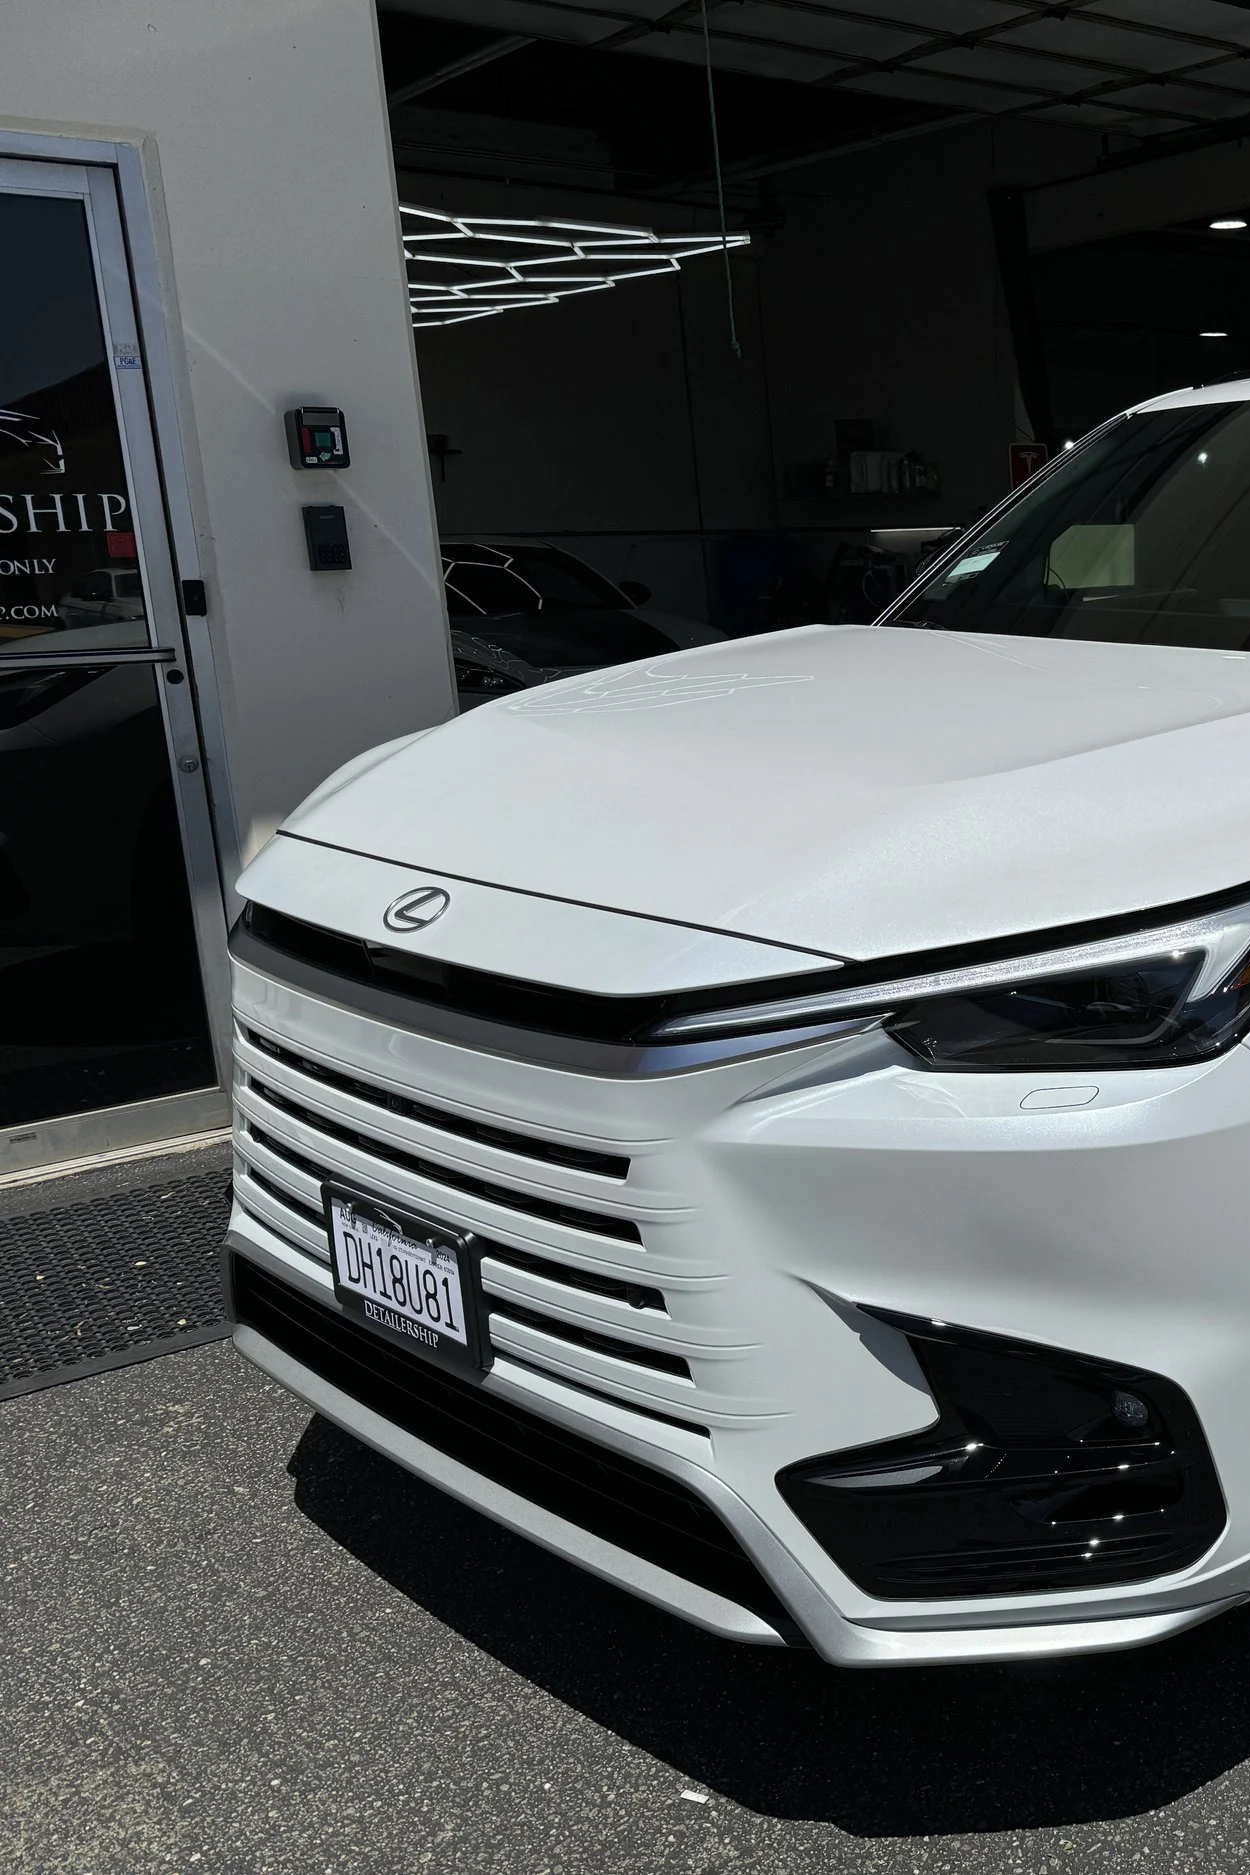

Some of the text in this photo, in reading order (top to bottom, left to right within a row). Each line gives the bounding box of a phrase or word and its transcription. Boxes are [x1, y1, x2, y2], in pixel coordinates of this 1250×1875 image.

[0, 493, 127, 534] SHIP
[0, 559, 57, 575] ONLY
[343, 1231, 460, 1333] DH18U81
[364, 1300, 439, 1348] DETAILERSHIP
